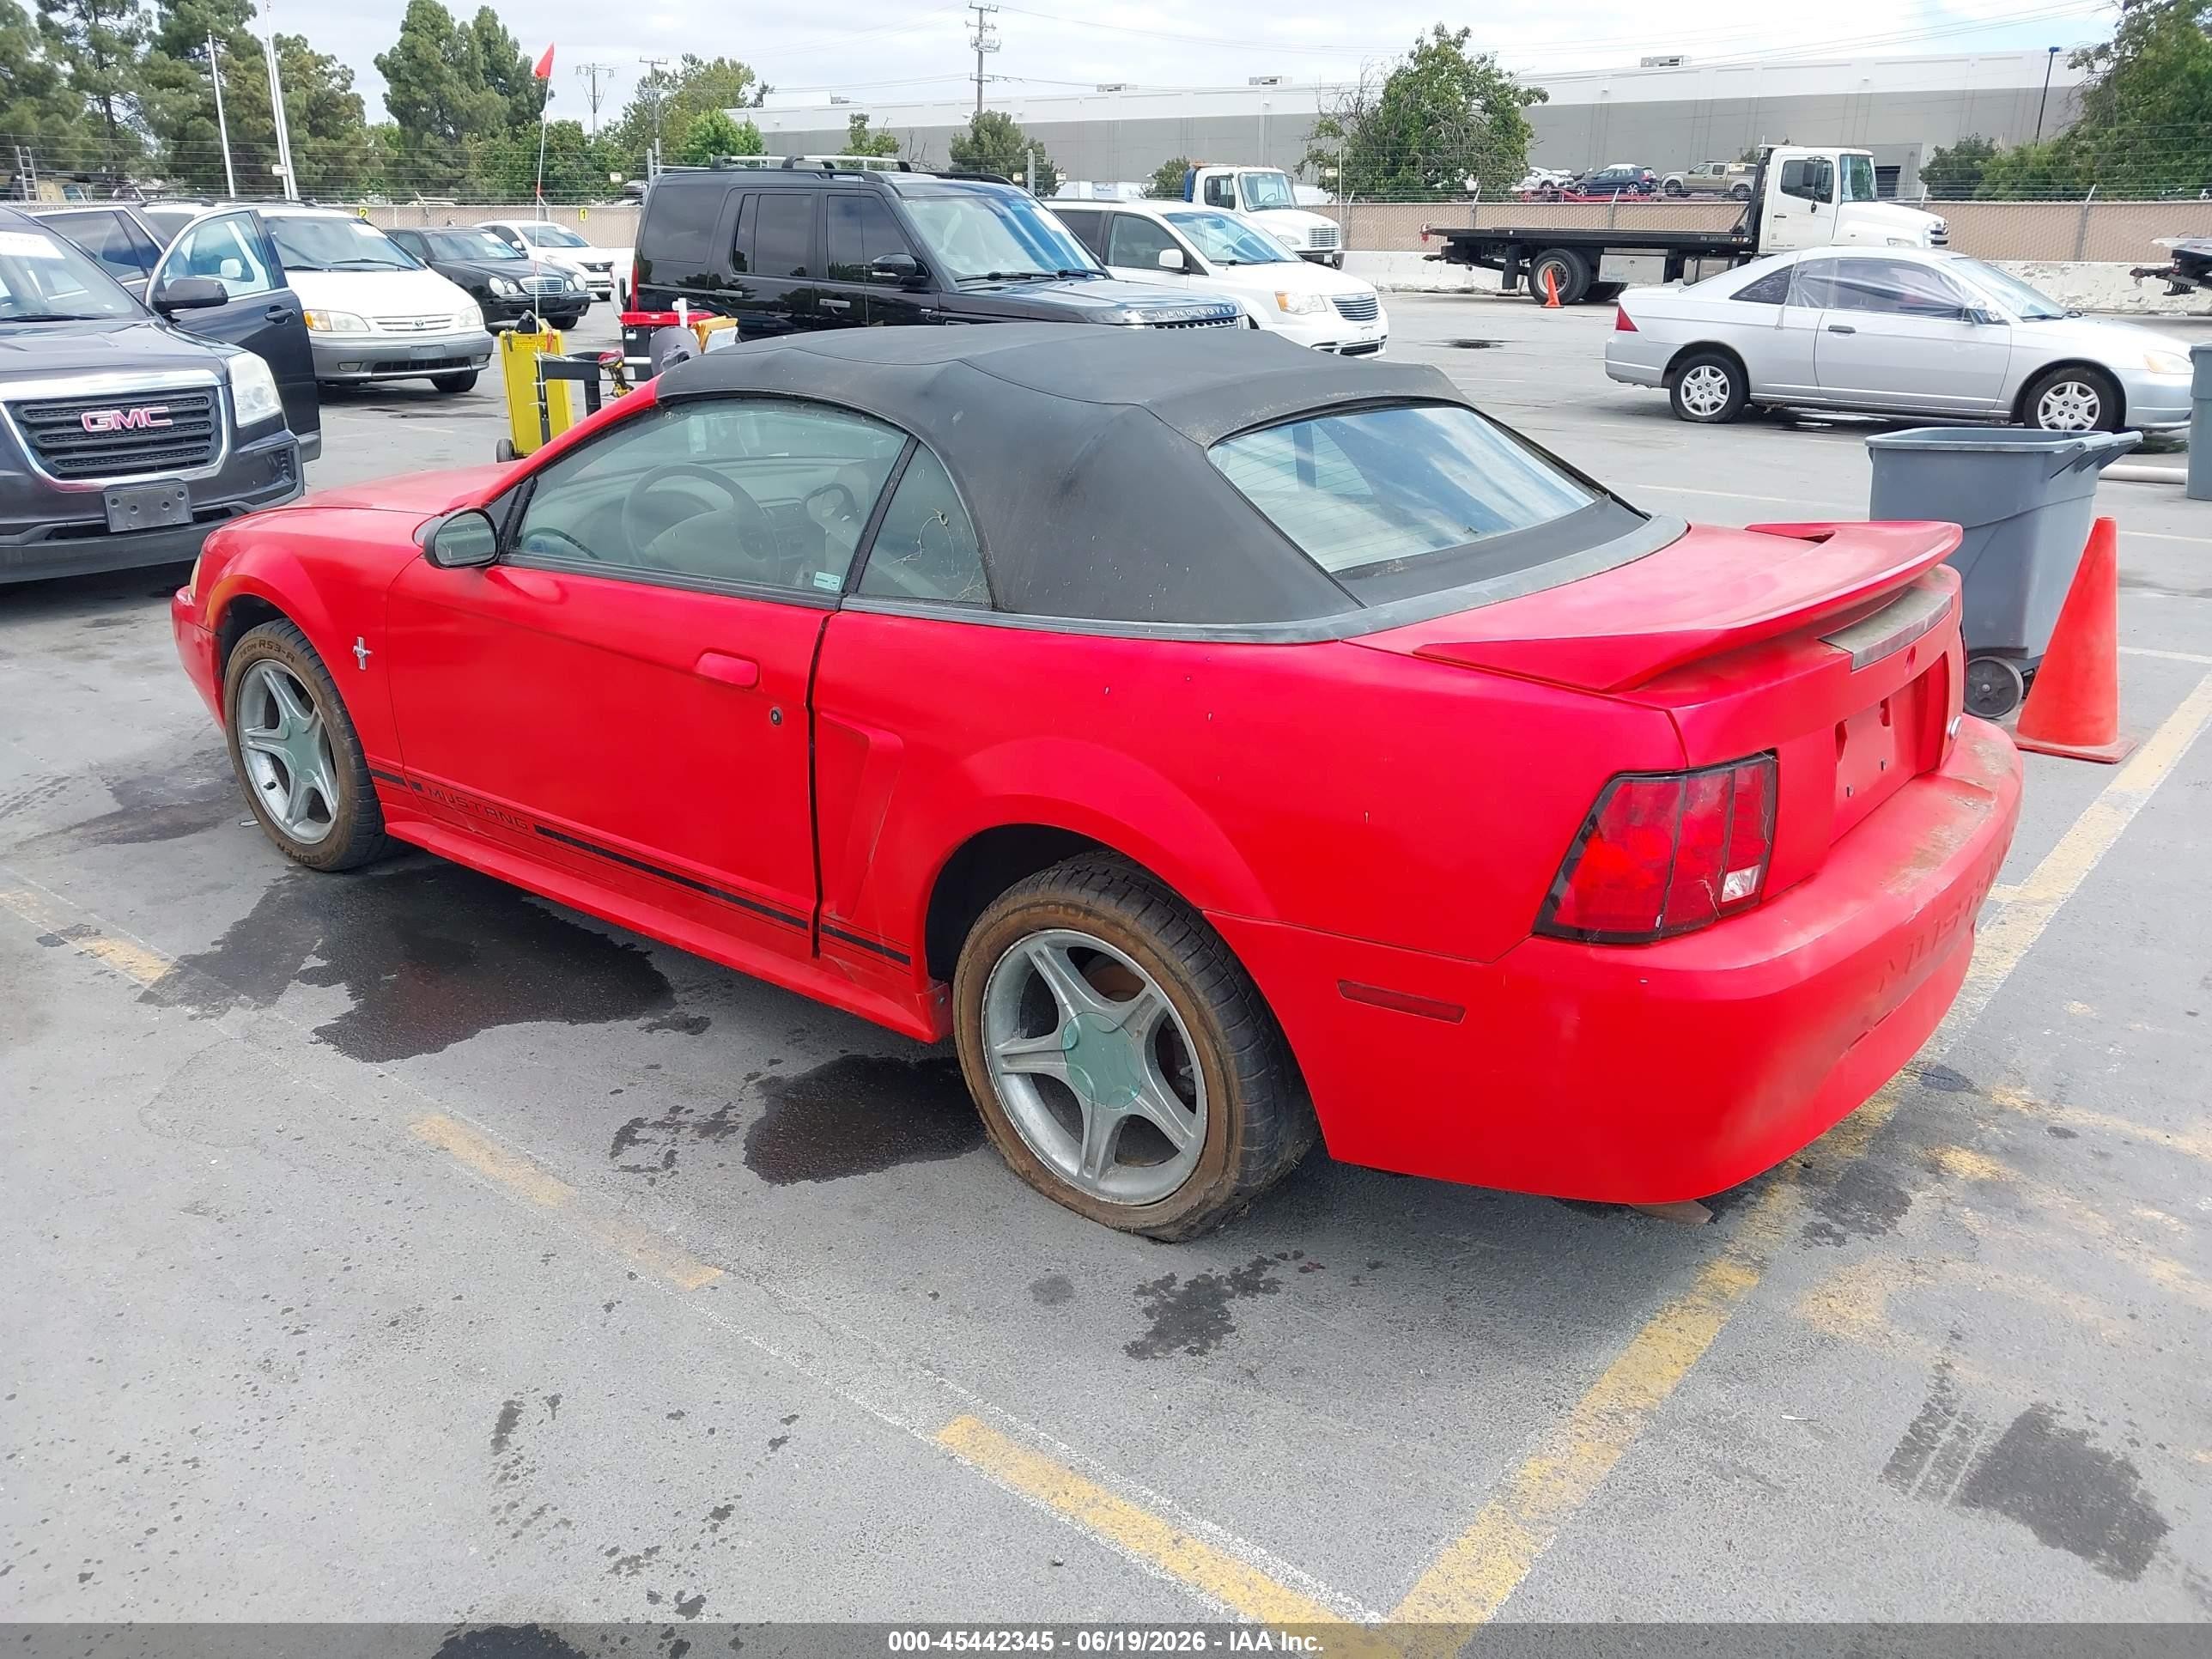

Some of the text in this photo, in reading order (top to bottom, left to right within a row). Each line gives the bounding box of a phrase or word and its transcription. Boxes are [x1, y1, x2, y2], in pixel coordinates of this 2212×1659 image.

[1156, 306, 1234, 319] LAND ROVER
[82, 406, 173, 432] GMC
[428, 787, 529, 830] MUSTANG
